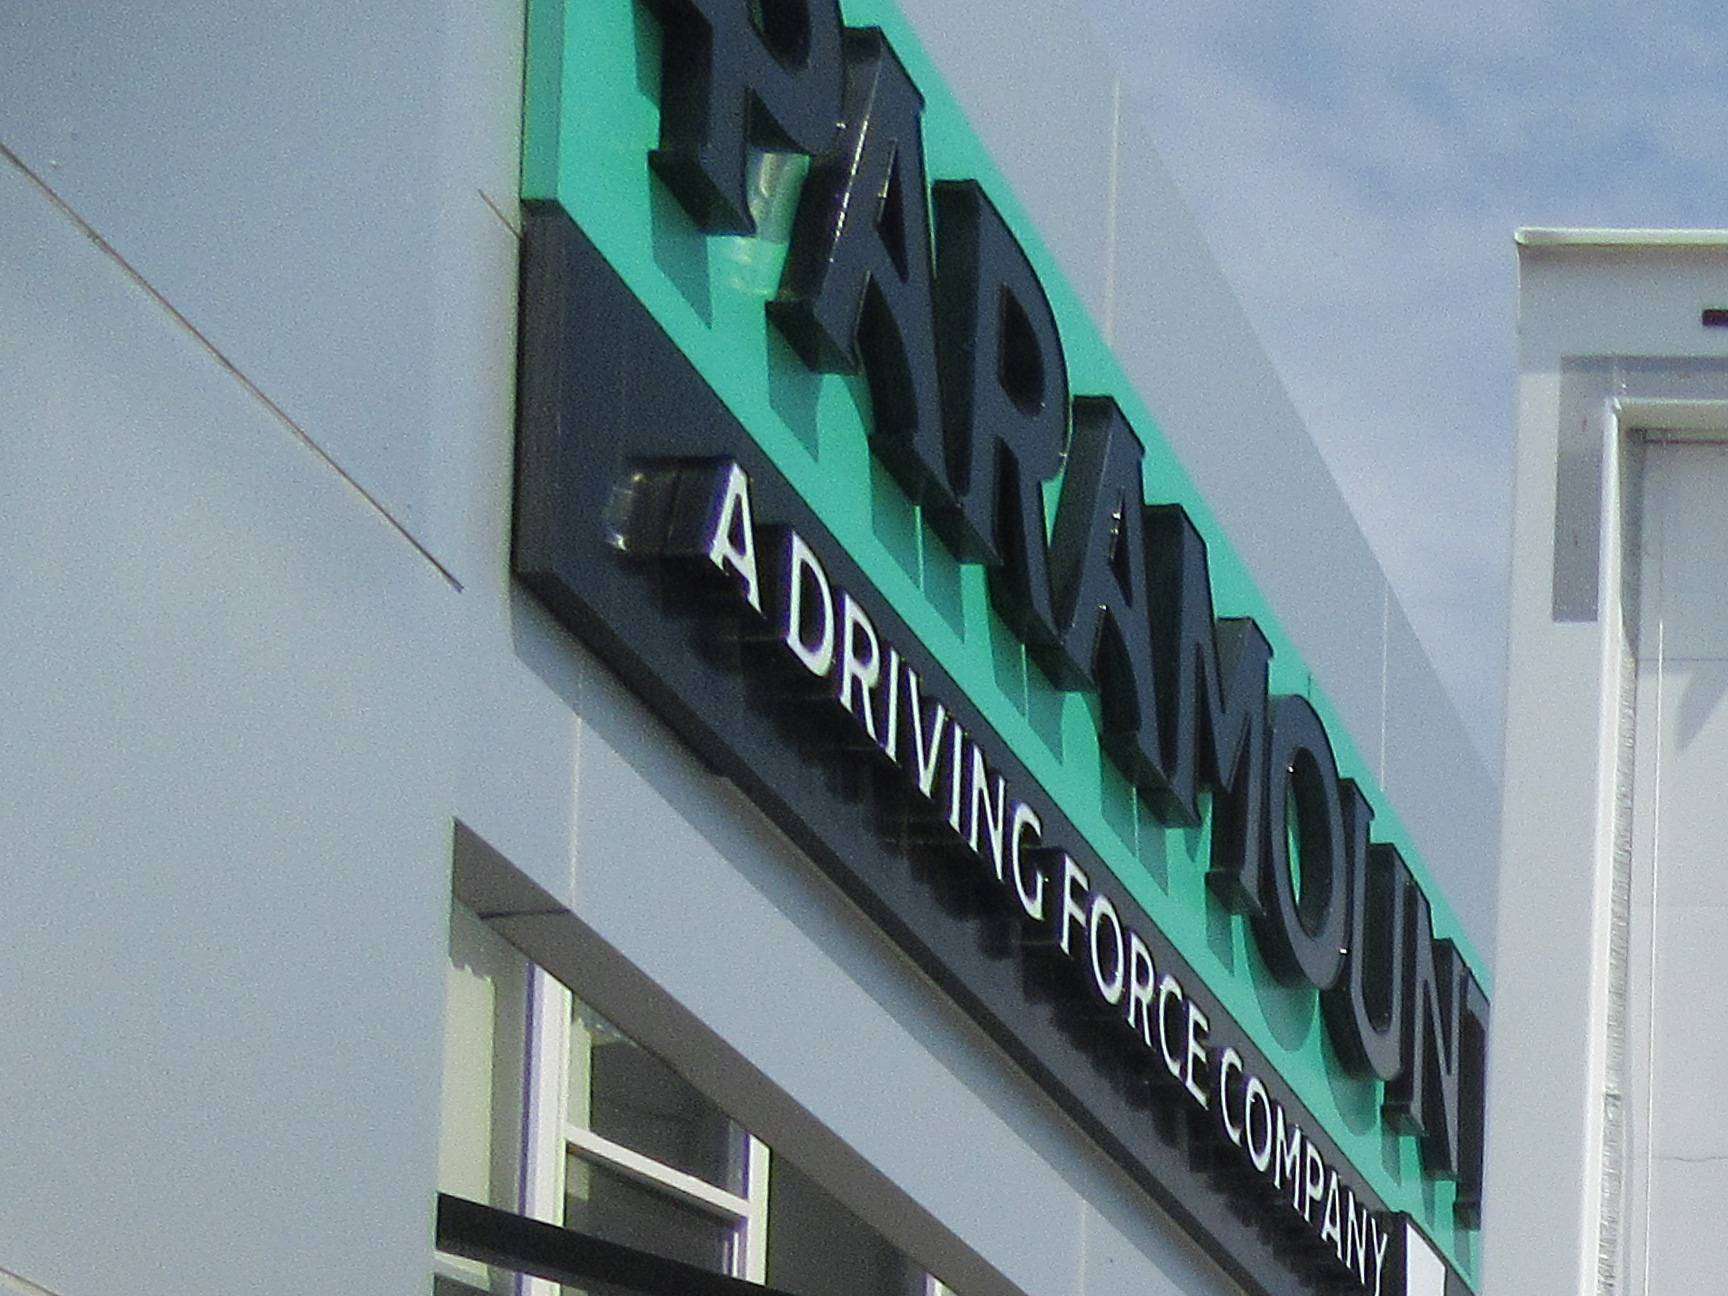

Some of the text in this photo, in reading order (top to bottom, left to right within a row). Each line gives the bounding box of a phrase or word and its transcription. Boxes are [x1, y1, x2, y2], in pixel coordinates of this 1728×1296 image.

[709, 461, 762, 613] A
[786, 530, 1044, 922] DRIVING
[1060, 853, 1211, 1111] FORCE
